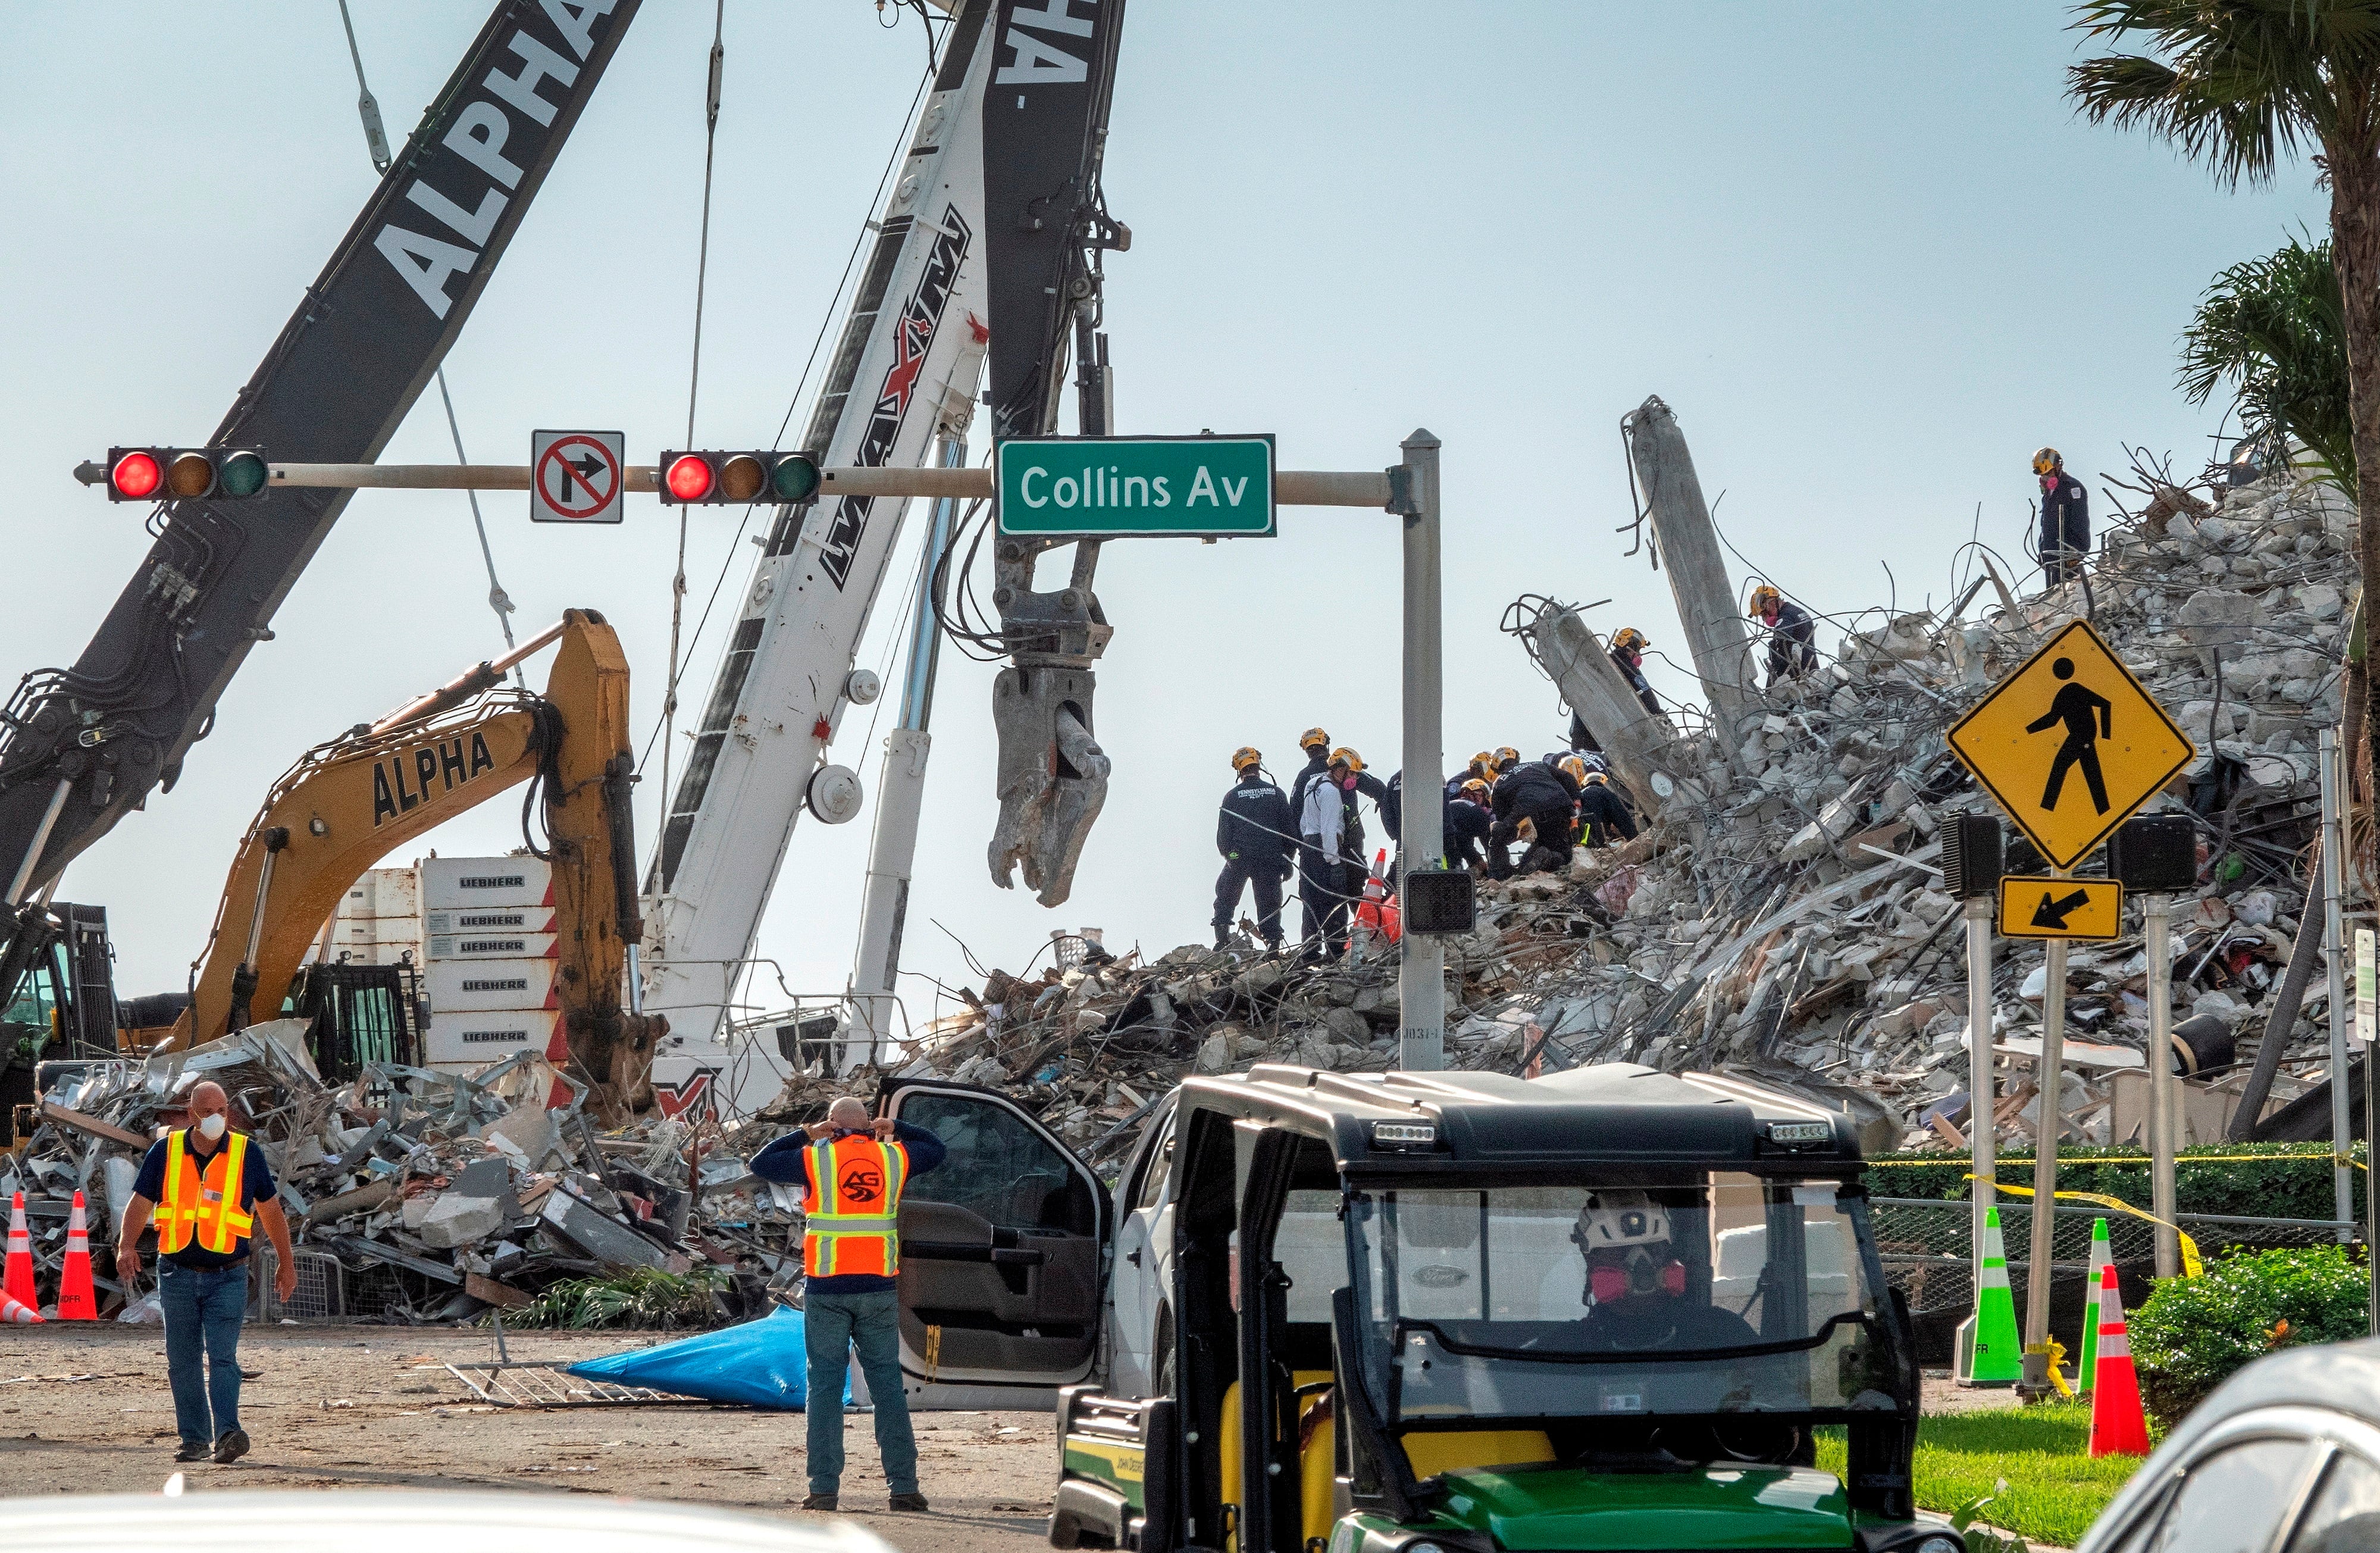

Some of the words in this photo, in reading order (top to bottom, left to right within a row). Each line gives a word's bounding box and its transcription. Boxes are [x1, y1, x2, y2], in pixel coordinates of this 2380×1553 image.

[374, 0, 617, 320] ALPHA
[1020, 465, 1172, 508] Collins
[1186, 466, 1249, 508] Av
[372, 731, 495, 827] ALPHA
[1238, 788, 1276, 796] PENNSYLVANIA
[461, 877, 524, 887] LIEBHERR
[461, 916, 523, 925] LIEBHERR
[461, 941, 524, 951] LIEBHERR
[464, 980, 526, 991] LIEBHERR
[464, 1032, 526, 1041] LIEBHERR
[2189, 1266, 2201, 1277] OT
